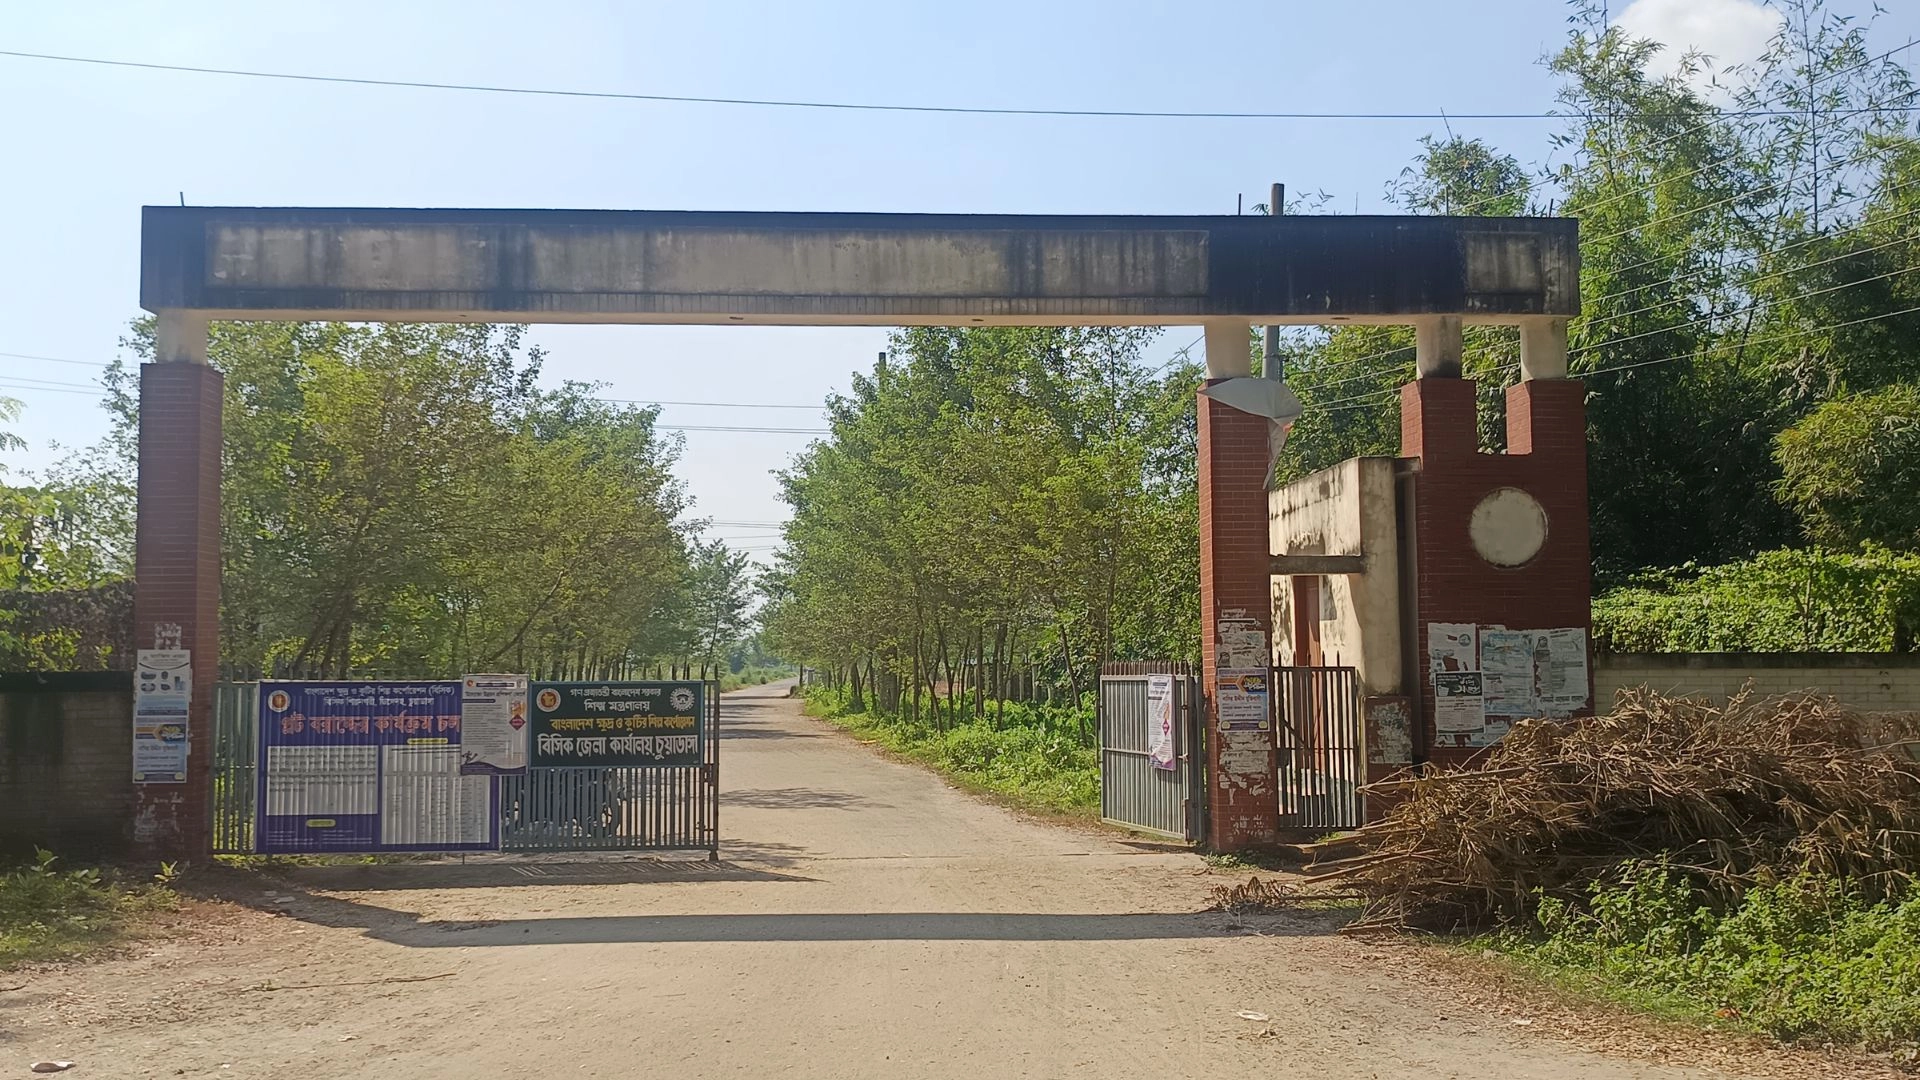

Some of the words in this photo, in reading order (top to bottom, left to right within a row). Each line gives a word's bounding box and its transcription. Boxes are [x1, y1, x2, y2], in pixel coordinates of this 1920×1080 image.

[304, 687, 335, 697] বাংলাদেশ
[611, 687, 641, 698] বাংলাদেশ
[584, 698, 606, 712] শিল্প
[609, 700, 650, 712] মন্ত্রণালয়
[550, 718, 594, 731] বাংলাদেশ
[596, 718, 614, 732] ক্ষুদ্র
[616, 717, 624, 729] ও
[624, 714, 647, 732] কুটির
[648, 714, 663, 729] শিল্প
[537, 733, 574, 757] বিসিক
[576, 735, 607, 758] জেলা
[655, 734, 698, 760] চুয়াডাঙ্গা
